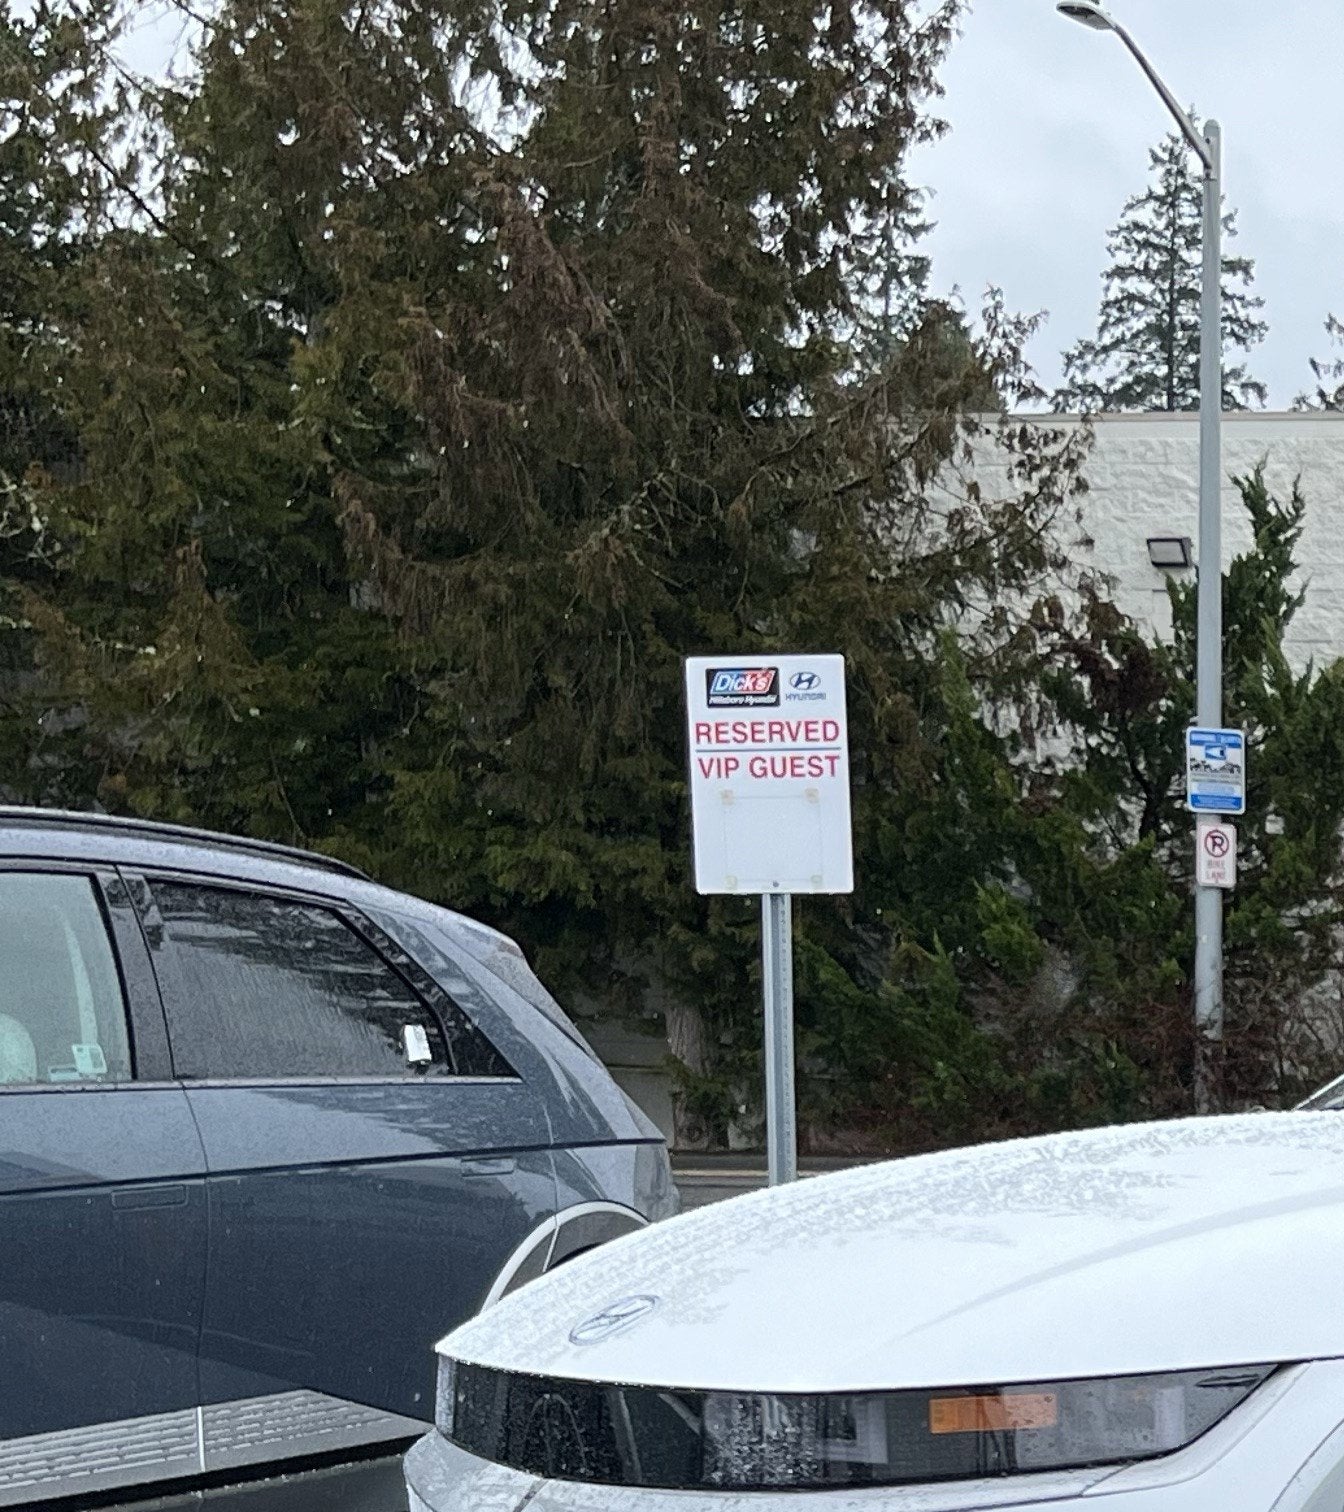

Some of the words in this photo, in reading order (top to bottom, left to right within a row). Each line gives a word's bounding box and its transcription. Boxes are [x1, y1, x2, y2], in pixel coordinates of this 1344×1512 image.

[695, 720, 840, 744] RESERVED
[697, 756, 740, 779] VIP
[749, 755, 841, 779] GUEST
